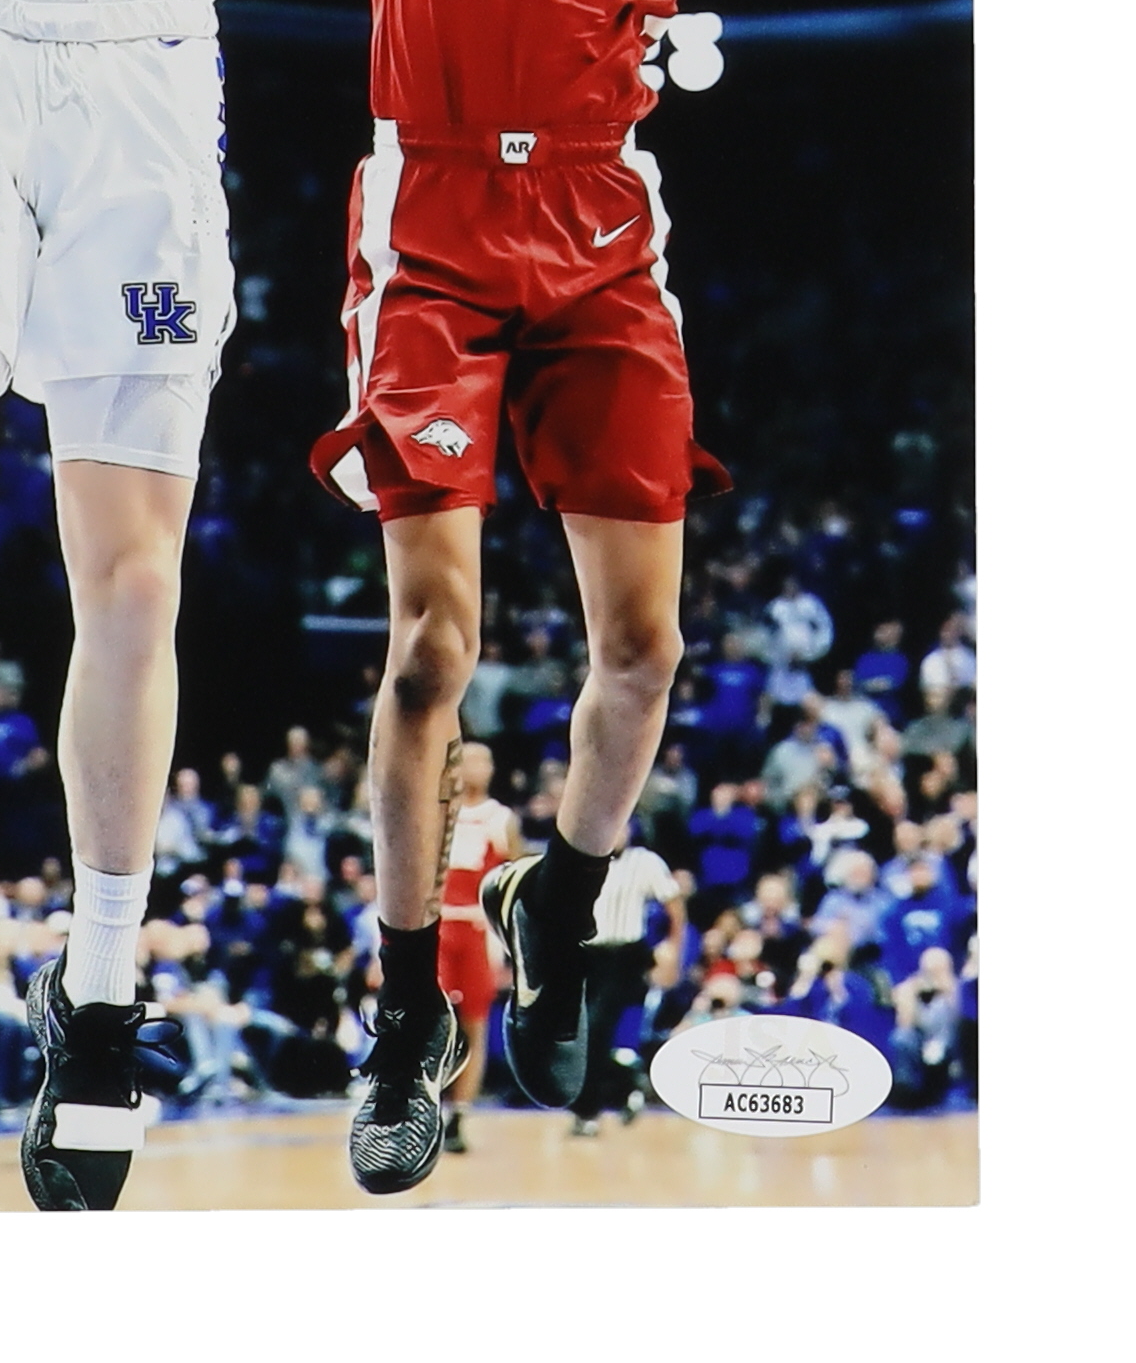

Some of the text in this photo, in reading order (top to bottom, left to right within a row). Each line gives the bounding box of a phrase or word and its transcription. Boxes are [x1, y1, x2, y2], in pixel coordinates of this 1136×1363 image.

[505, 141, 530, 154] AR
[121, 282, 197, 345] UK
[724, 1092, 804, 1114] AC63683
